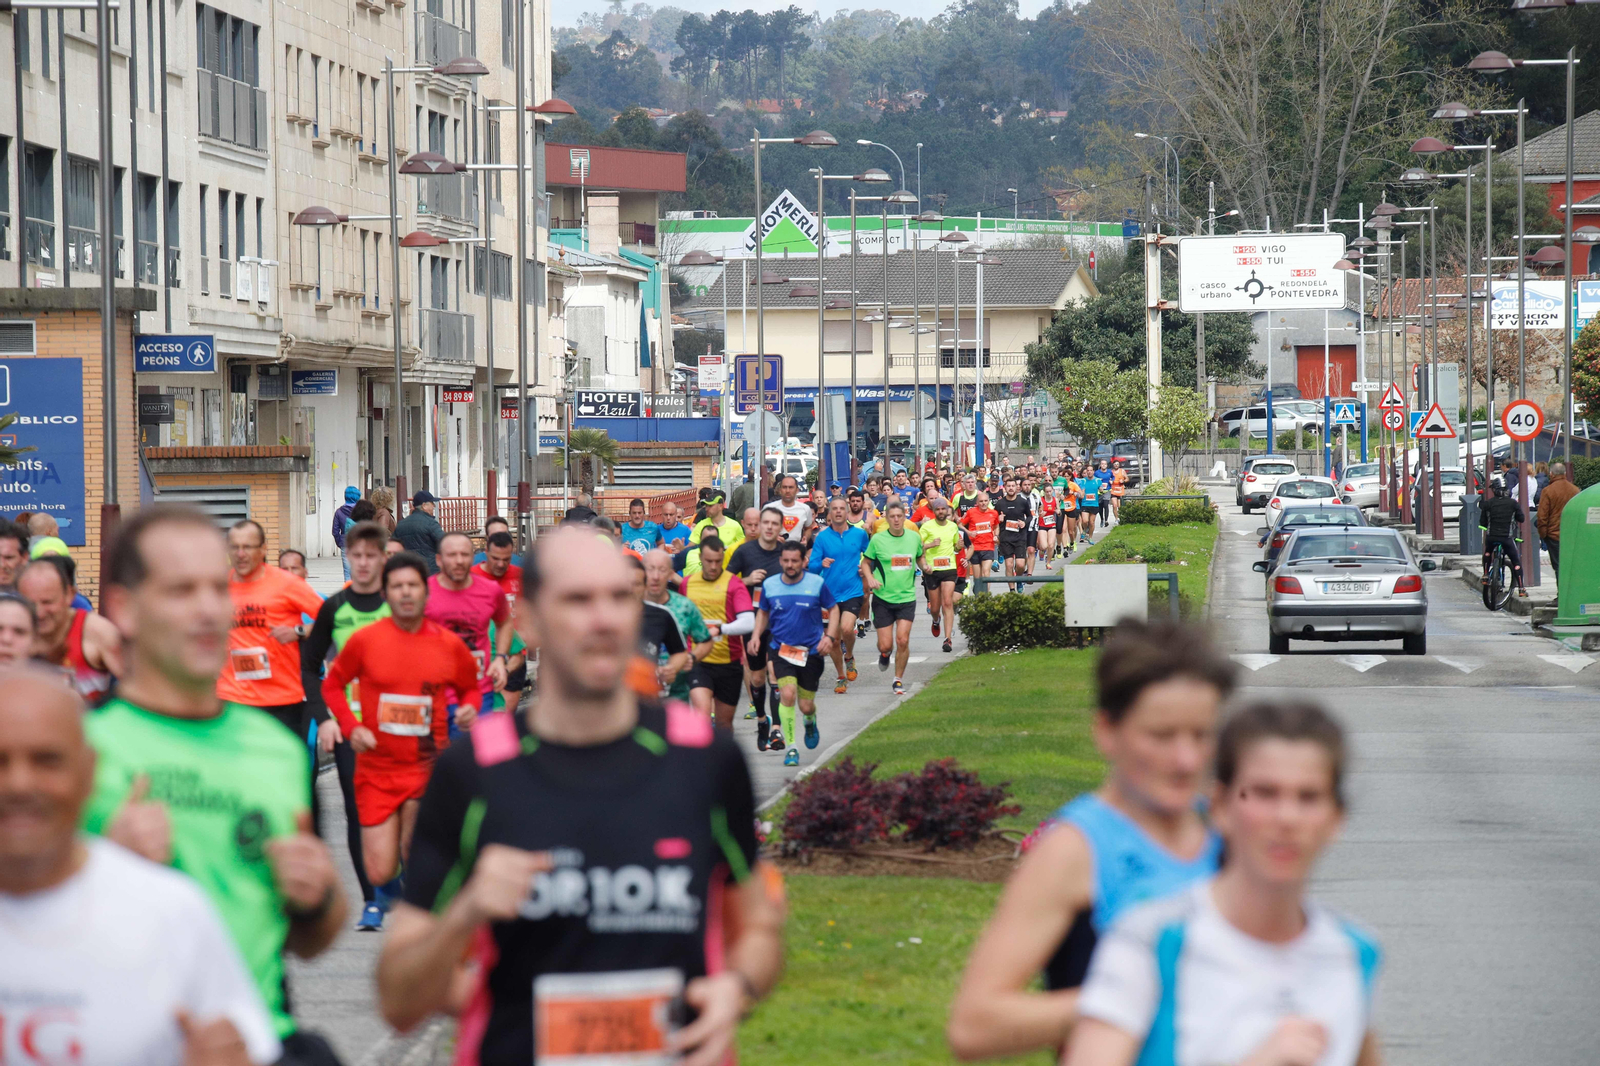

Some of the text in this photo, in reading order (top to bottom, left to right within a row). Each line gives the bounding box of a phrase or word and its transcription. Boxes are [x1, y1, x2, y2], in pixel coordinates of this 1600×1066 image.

[1261, 245, 1286, 253] VIGO
[1200, 291, 1232, 299] urbano
[1270, 289, 1339, 298] PONTEVEDRA
[1501, 290, 1530, 299] Auts
[138, 343, 184, 352] ACCESO
[142, 354, 180, 365] PEÓNS
[746, 361, 772, 390] P
[443, 392, 473, 401] 34 89 89
[581, 392, 637, 403] HOTEL
[501, 409, 510, 418] 34
[596, 403, 635, 416] Azul
[10, 416, 78, 425] BLICO
[1387, 416, 1400, 424] 30
[1511, 413, 1535, 426] 40
[1331, 583, 1370, 592] 4334 BNG
